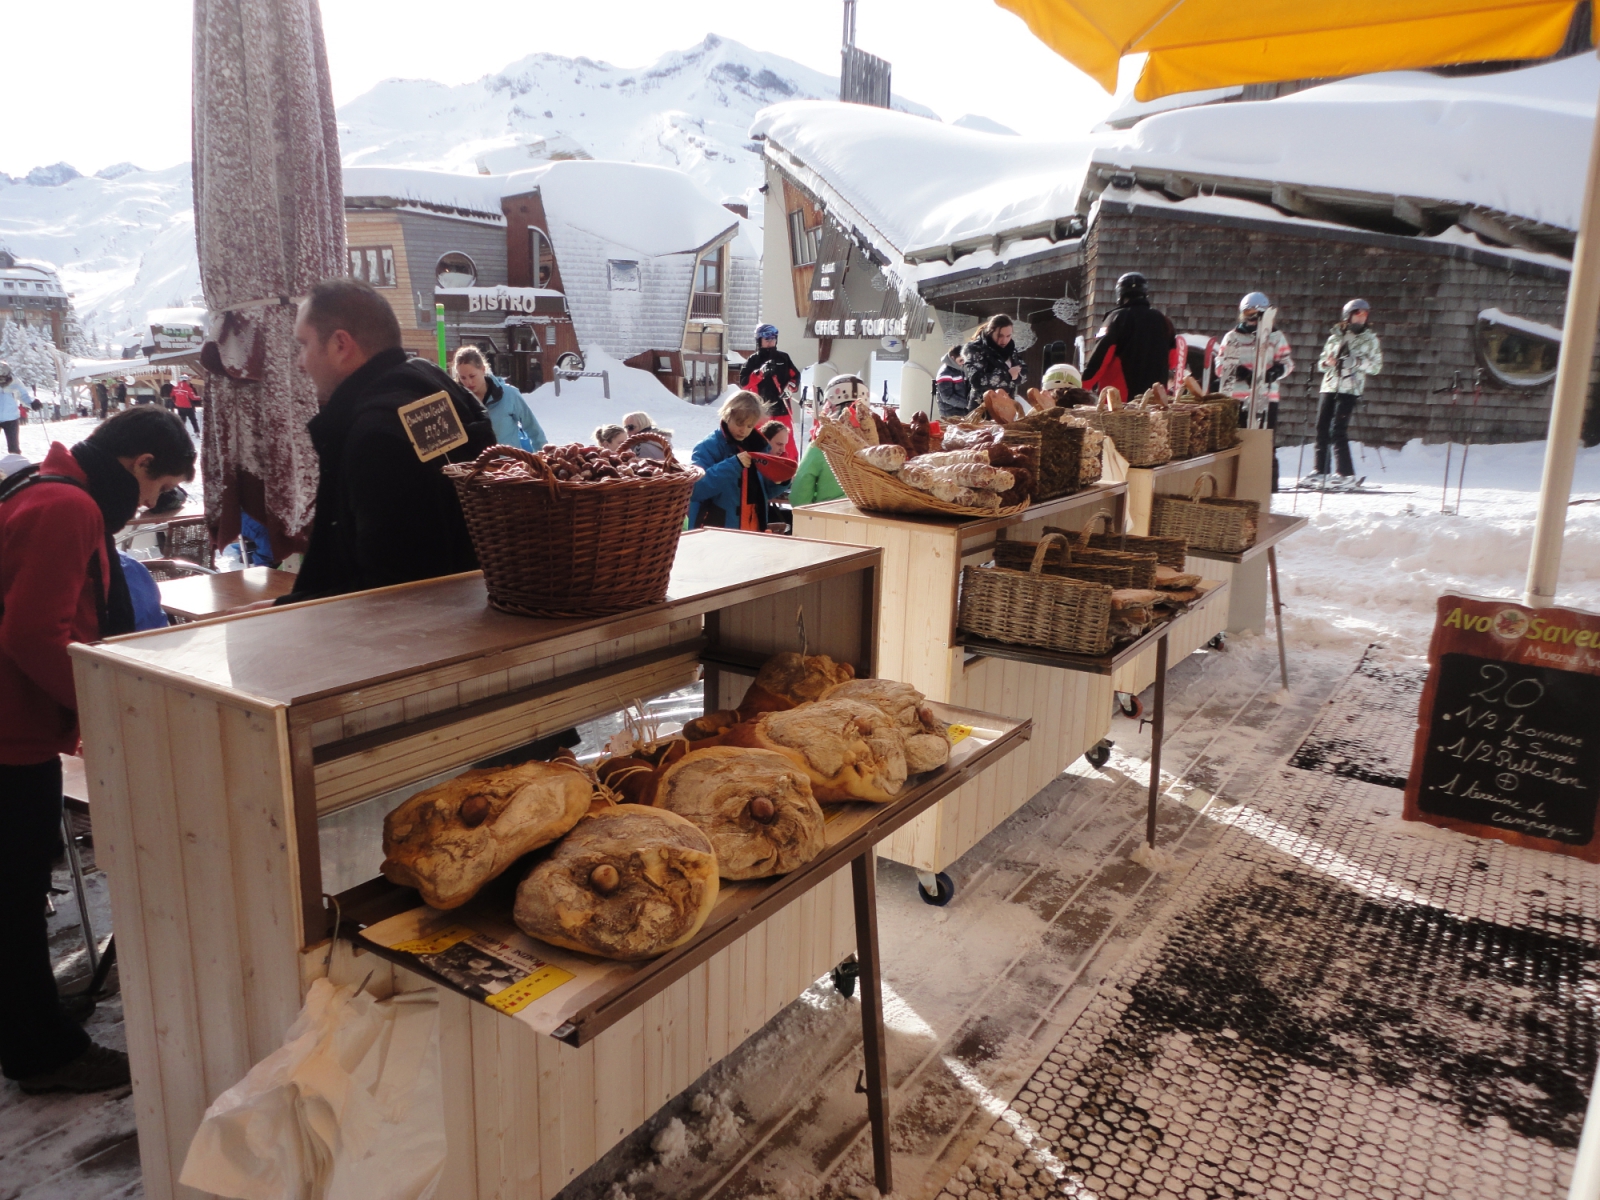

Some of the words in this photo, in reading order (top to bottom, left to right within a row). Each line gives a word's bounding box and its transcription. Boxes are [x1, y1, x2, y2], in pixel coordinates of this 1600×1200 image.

[469, 294, 536, 314] BISTRO
[814, 319, 840, 336] OFFICE
[844, 319, 857, 336] DE
[861, 315, 908, 336] TOURISME
[1443, 608, 1493, 633] Avo
[1469, 664, 1545, 708] 20
[1525, 742, 1577, 765] Savoie
[1494, 749, 1587, 789] Reblochon
[1527, 802, 1546, 818] de
